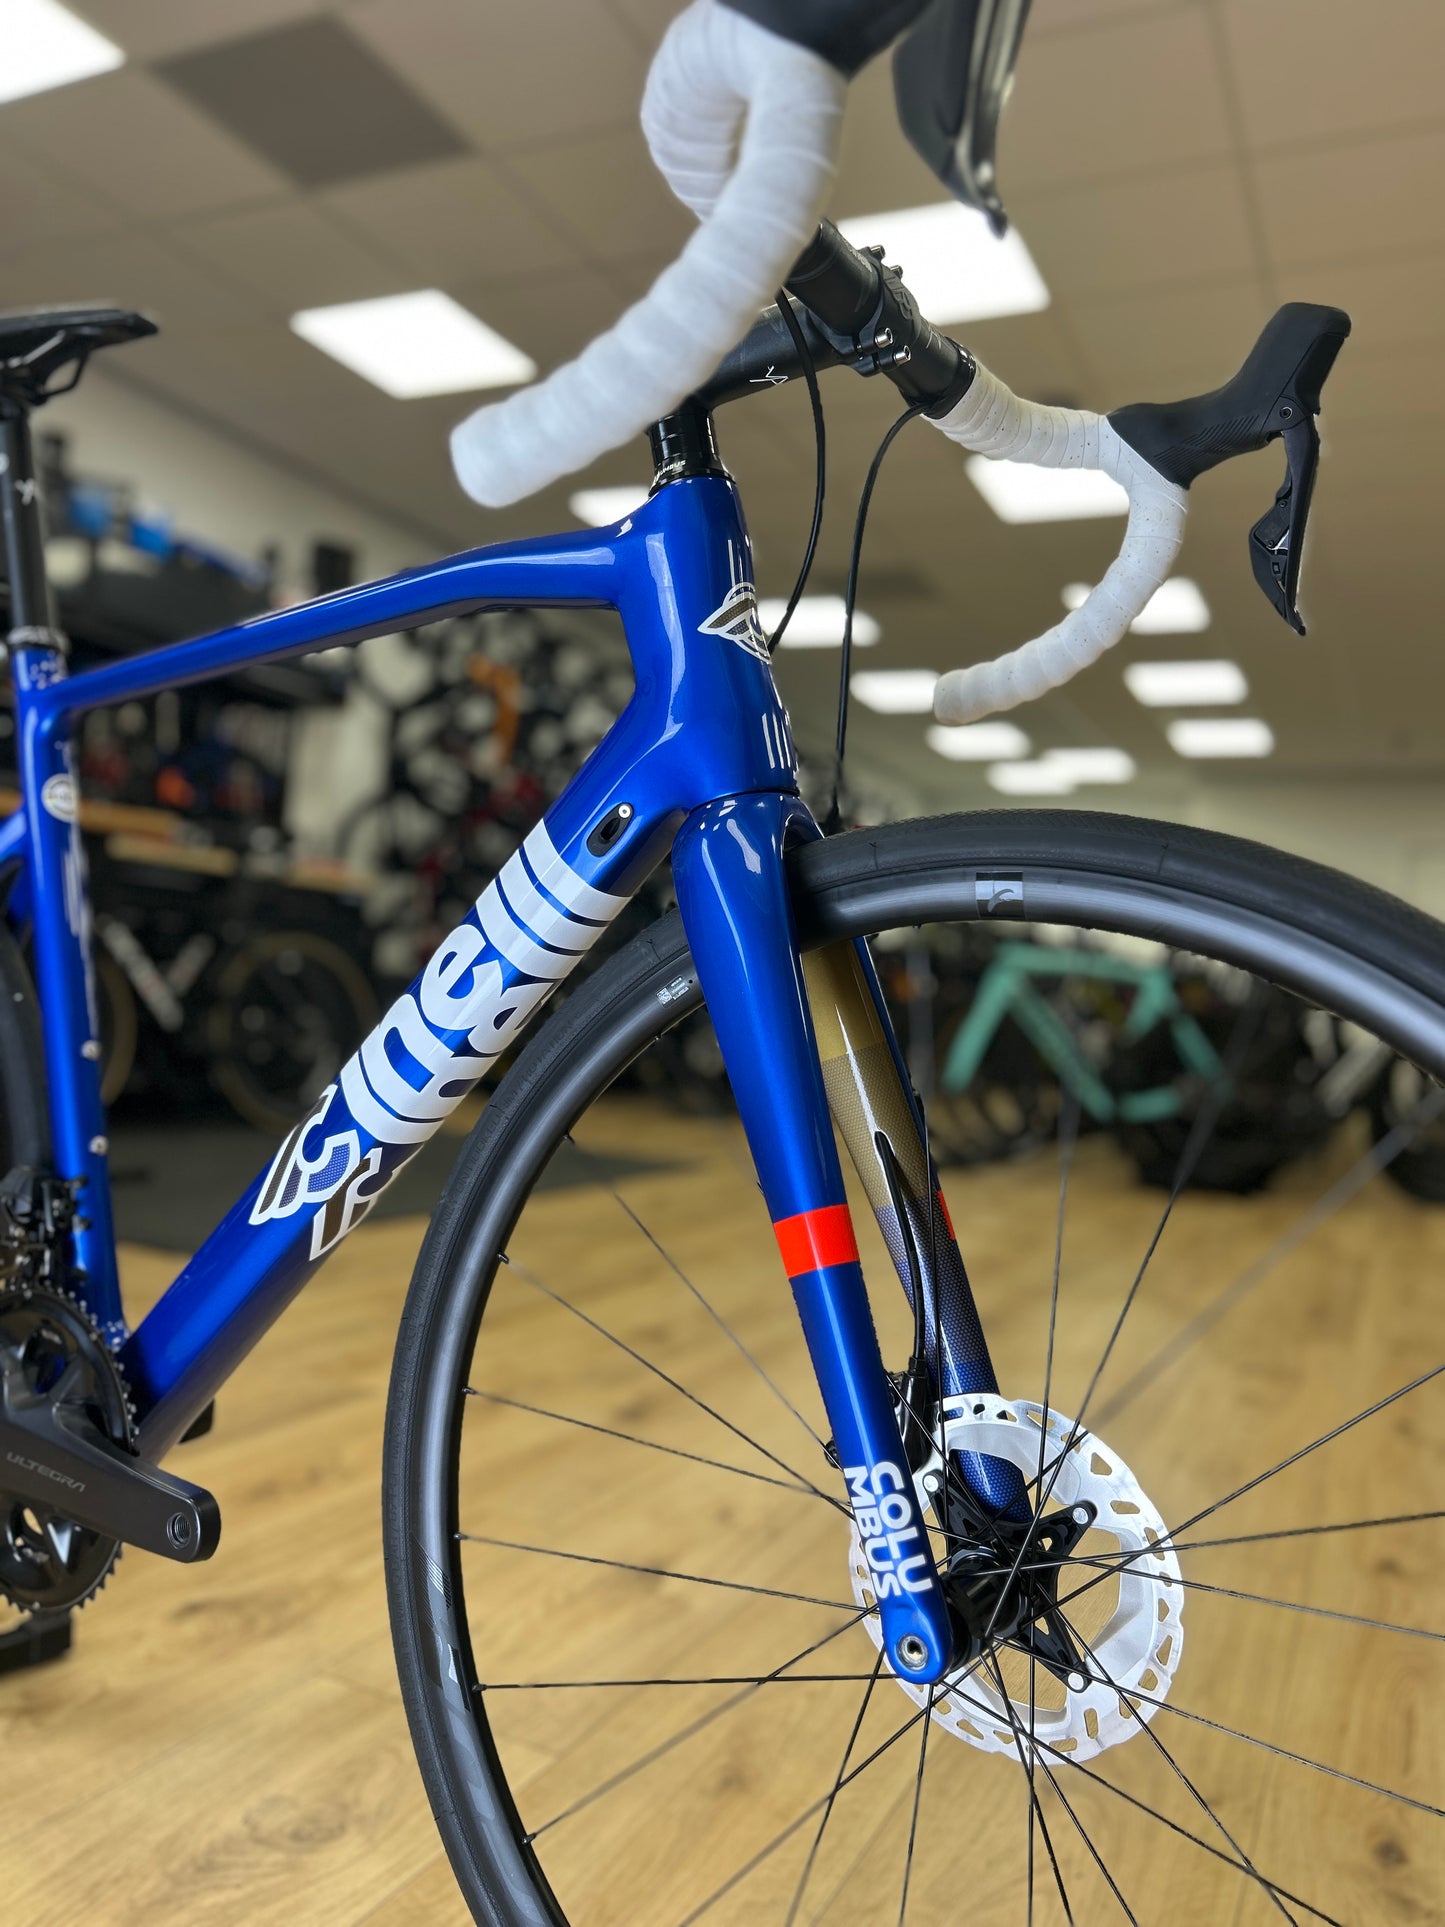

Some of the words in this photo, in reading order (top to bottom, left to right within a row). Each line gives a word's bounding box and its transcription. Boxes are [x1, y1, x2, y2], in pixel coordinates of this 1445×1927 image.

[6, 1452, 86, 1493] ULTEGRA
[844, 1465, 902, 1599] MBUS
[870, 1461, 933, 1593] COLU
